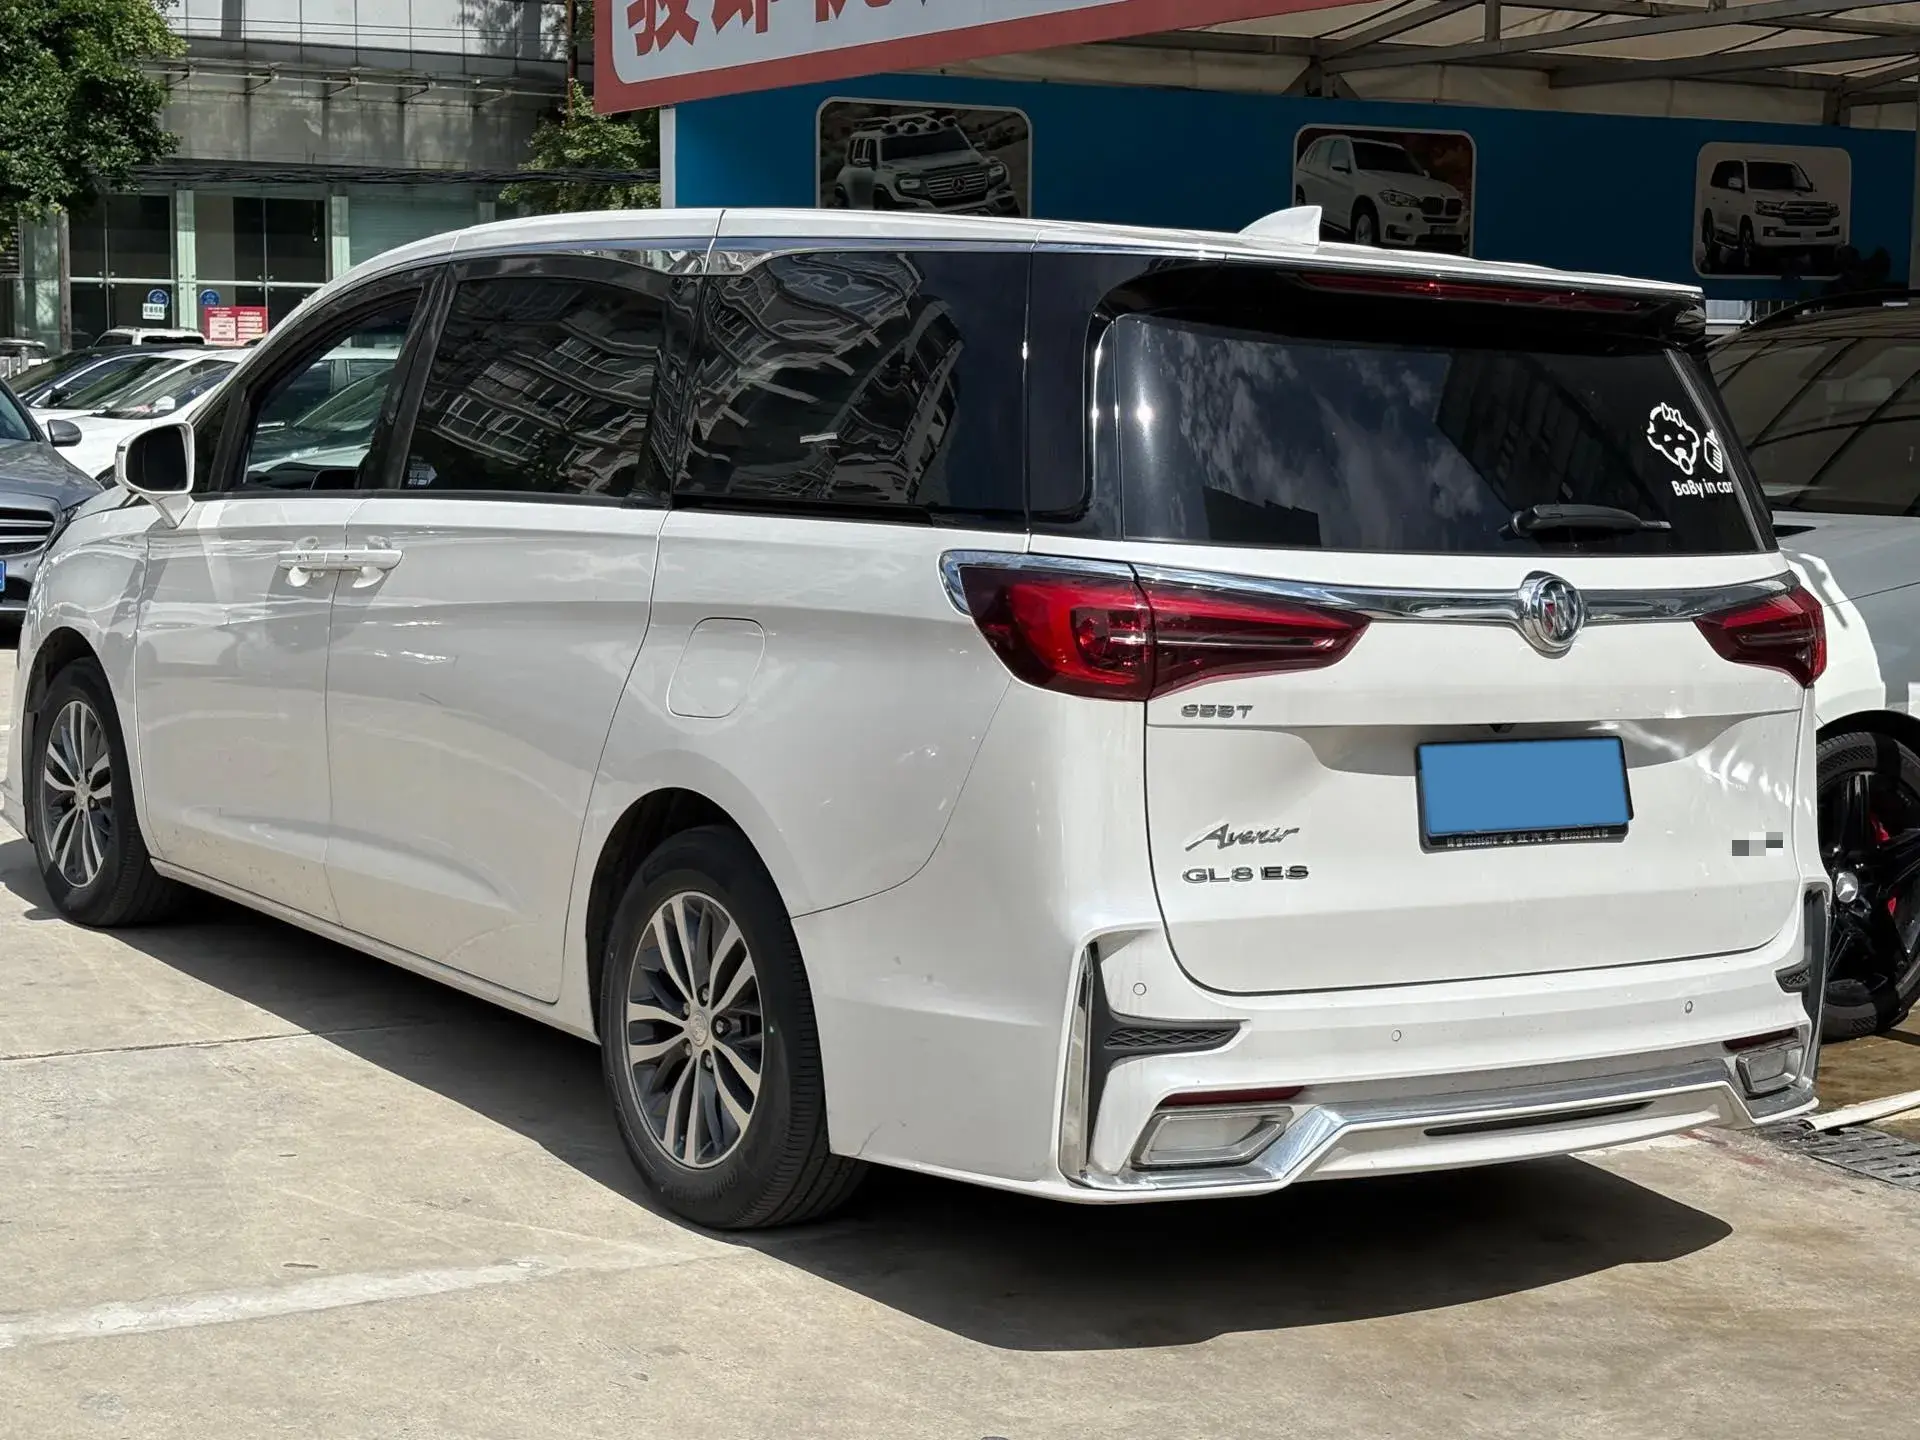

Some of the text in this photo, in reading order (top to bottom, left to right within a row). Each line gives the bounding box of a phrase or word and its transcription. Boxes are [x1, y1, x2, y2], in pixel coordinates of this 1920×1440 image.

[1702, 478, 1717, 494] in
[1716, 481, 1734, 493] car
[1185, 823, 1300, 852] Avenir
[1181, 865, 1310, 884] GL8 ES
